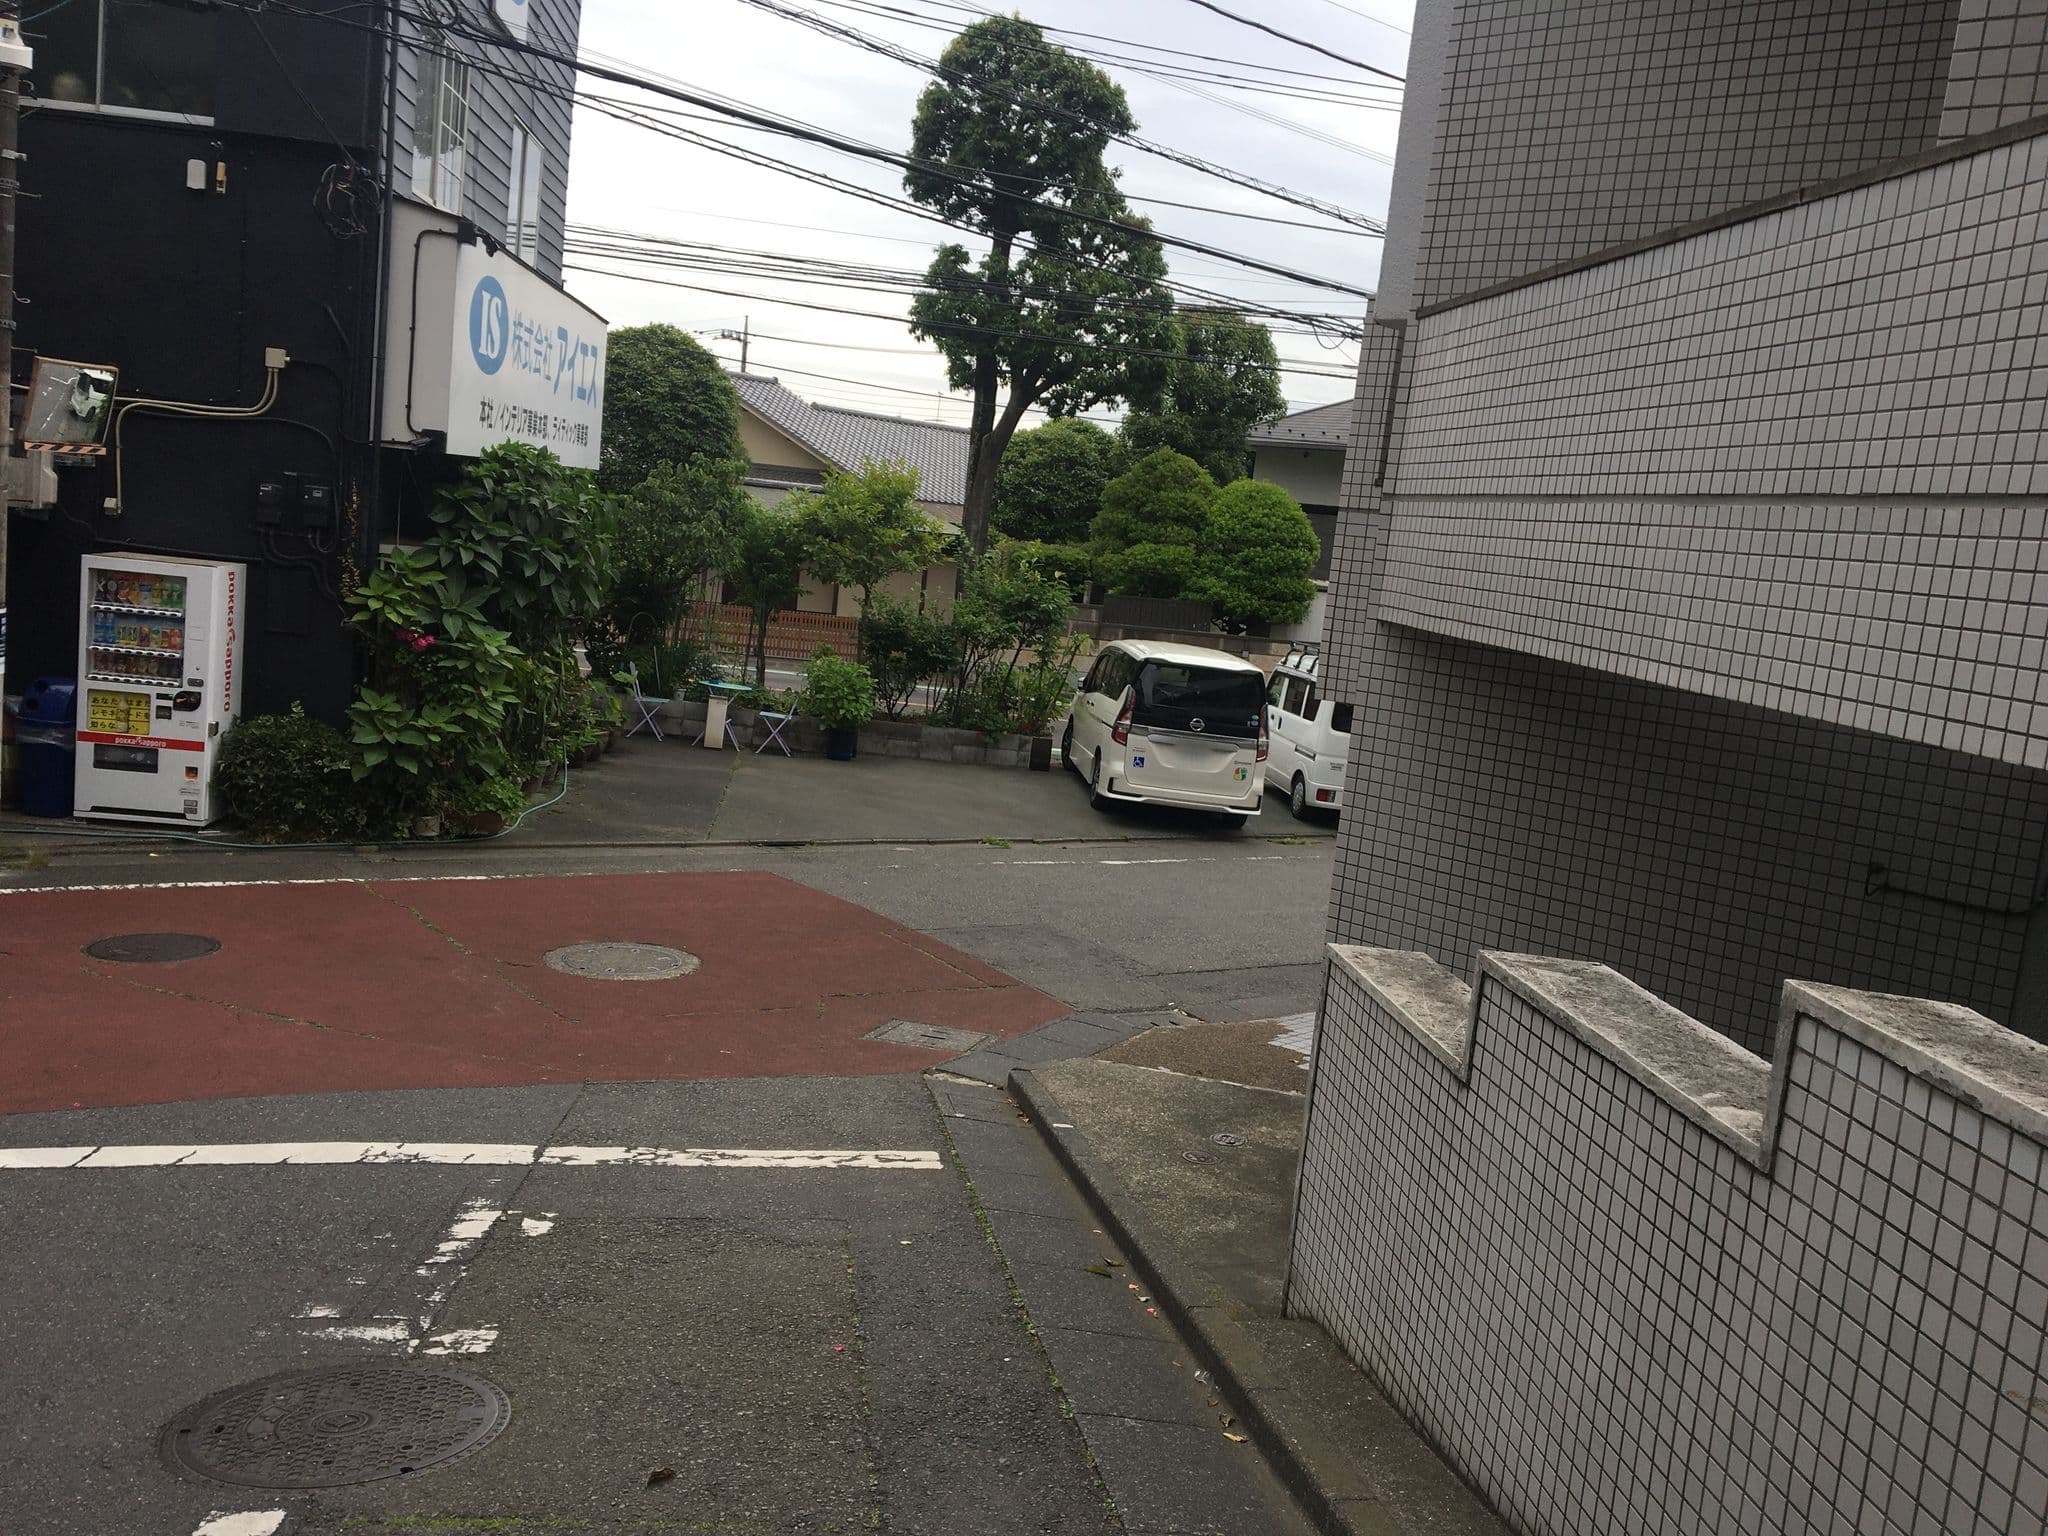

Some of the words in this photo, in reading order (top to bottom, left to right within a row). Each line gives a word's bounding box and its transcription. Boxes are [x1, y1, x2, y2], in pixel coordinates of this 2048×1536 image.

[479, 290, 502, 359] IS
[512, 308, 598, 408] 株式会社アイエス
